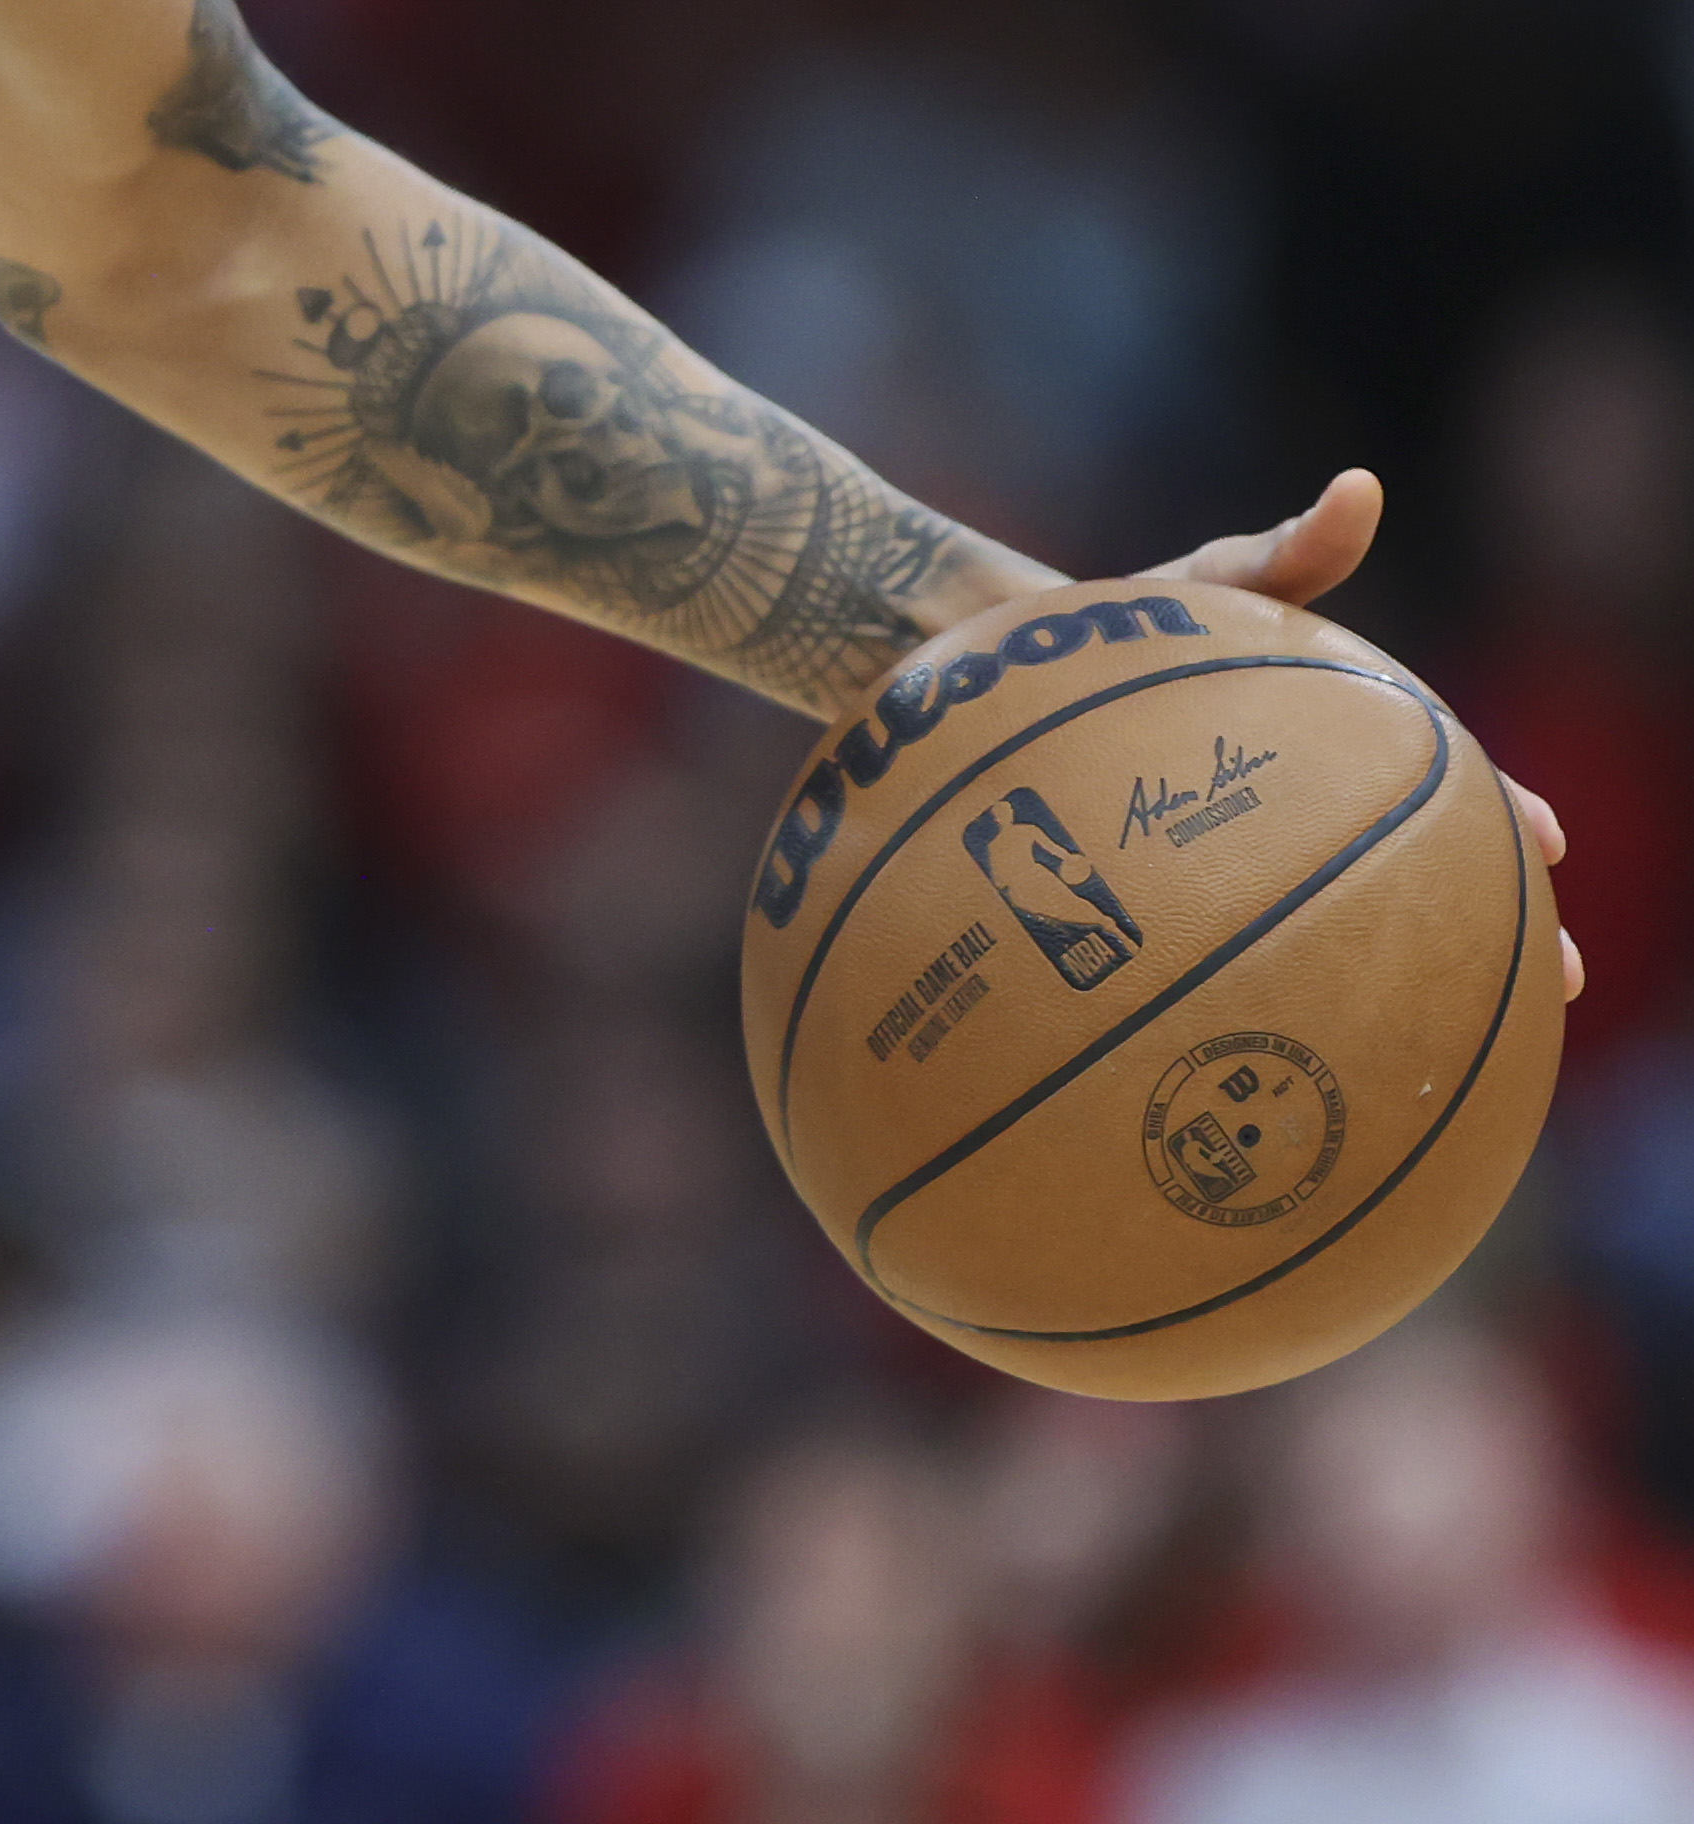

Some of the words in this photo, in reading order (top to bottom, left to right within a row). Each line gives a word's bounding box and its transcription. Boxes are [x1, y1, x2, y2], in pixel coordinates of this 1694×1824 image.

[1165, 786, 1262, 848] COMMISSIONER
[1061, 932, 1113, 982] NBA
[867, 991, 925, 1062] OFFICIAL
[915, 952, 963, 1005] GAME
[949, 921, 998, 969] BALL
[1202, 1036, 1269, 1059] DESIGNED
[1272, 1037, 1286, 1053] IN
[1288, 1043, 1314, 1068] USA
[1325, 1088, 1343, 1125] MADE
